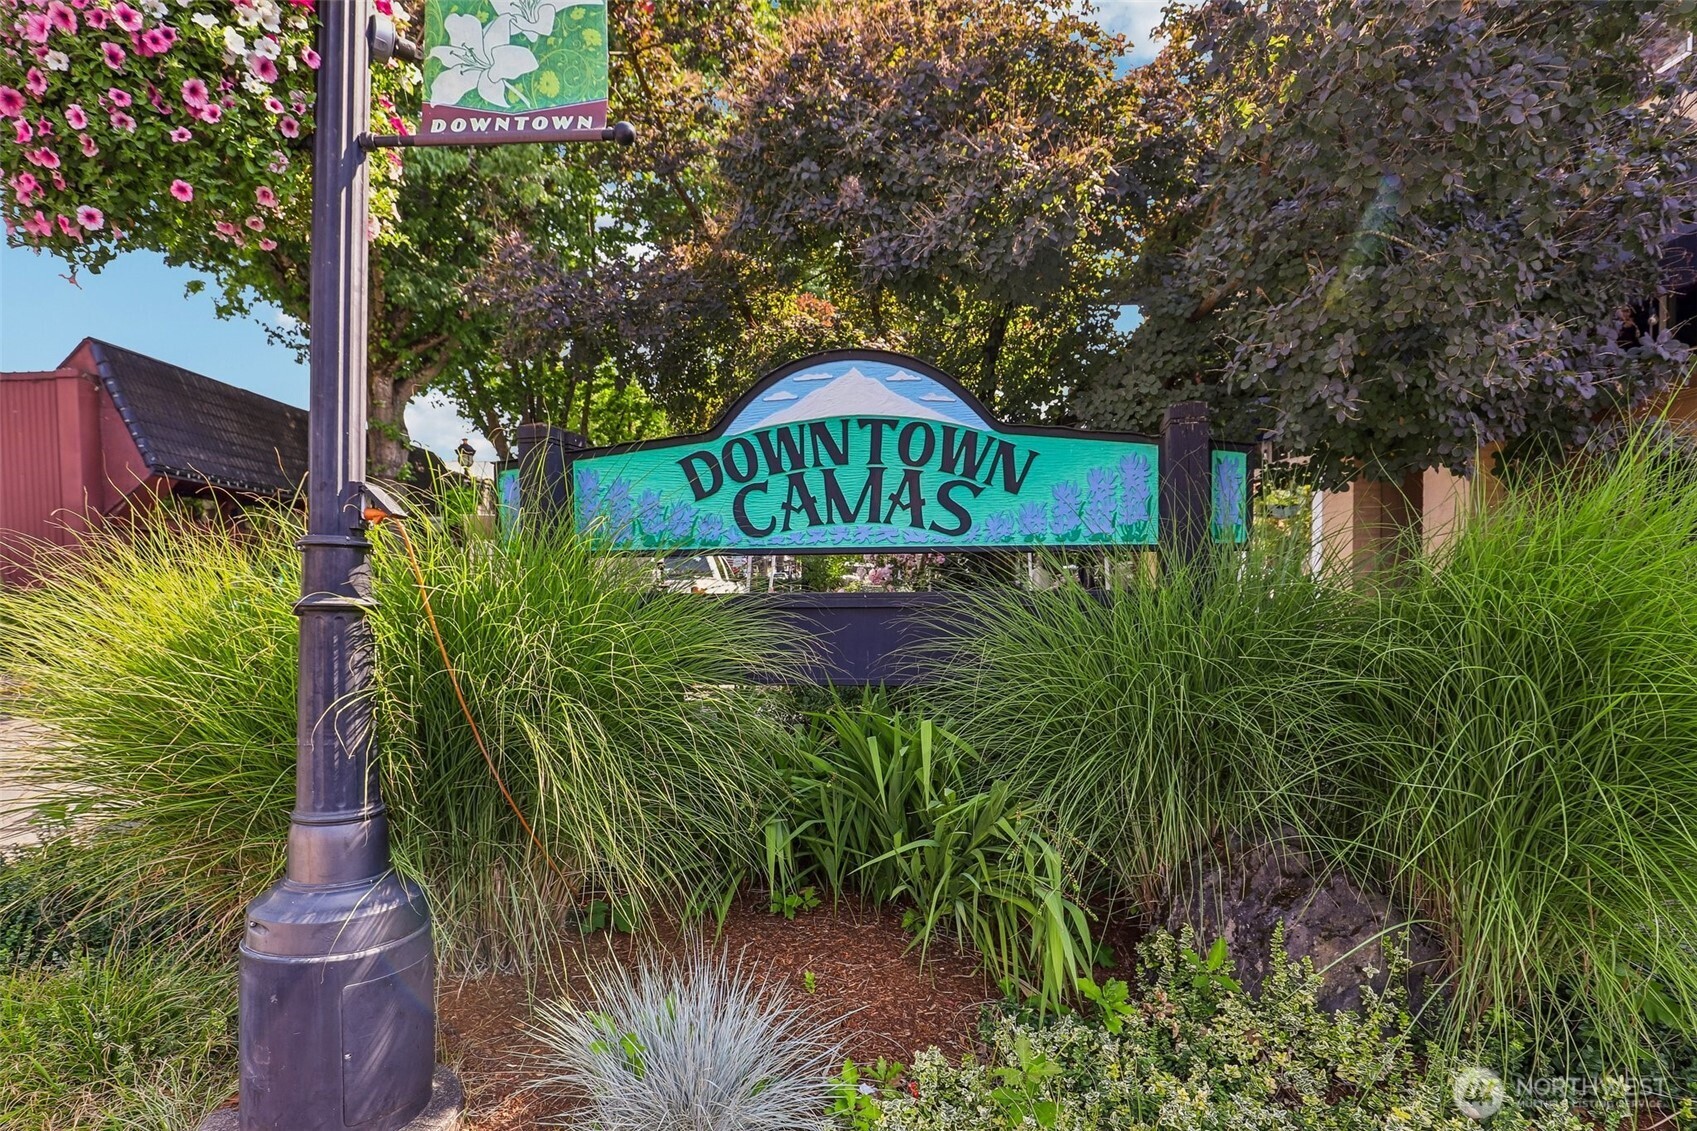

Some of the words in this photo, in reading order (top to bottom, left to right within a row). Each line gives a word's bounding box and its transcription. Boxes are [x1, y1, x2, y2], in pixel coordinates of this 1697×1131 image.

[431, 115, 593, 133] DOWNTOWN
[676, 418, 1040, 502] DOWNTOWN
[733, 466, 986, 537] CAMAS
